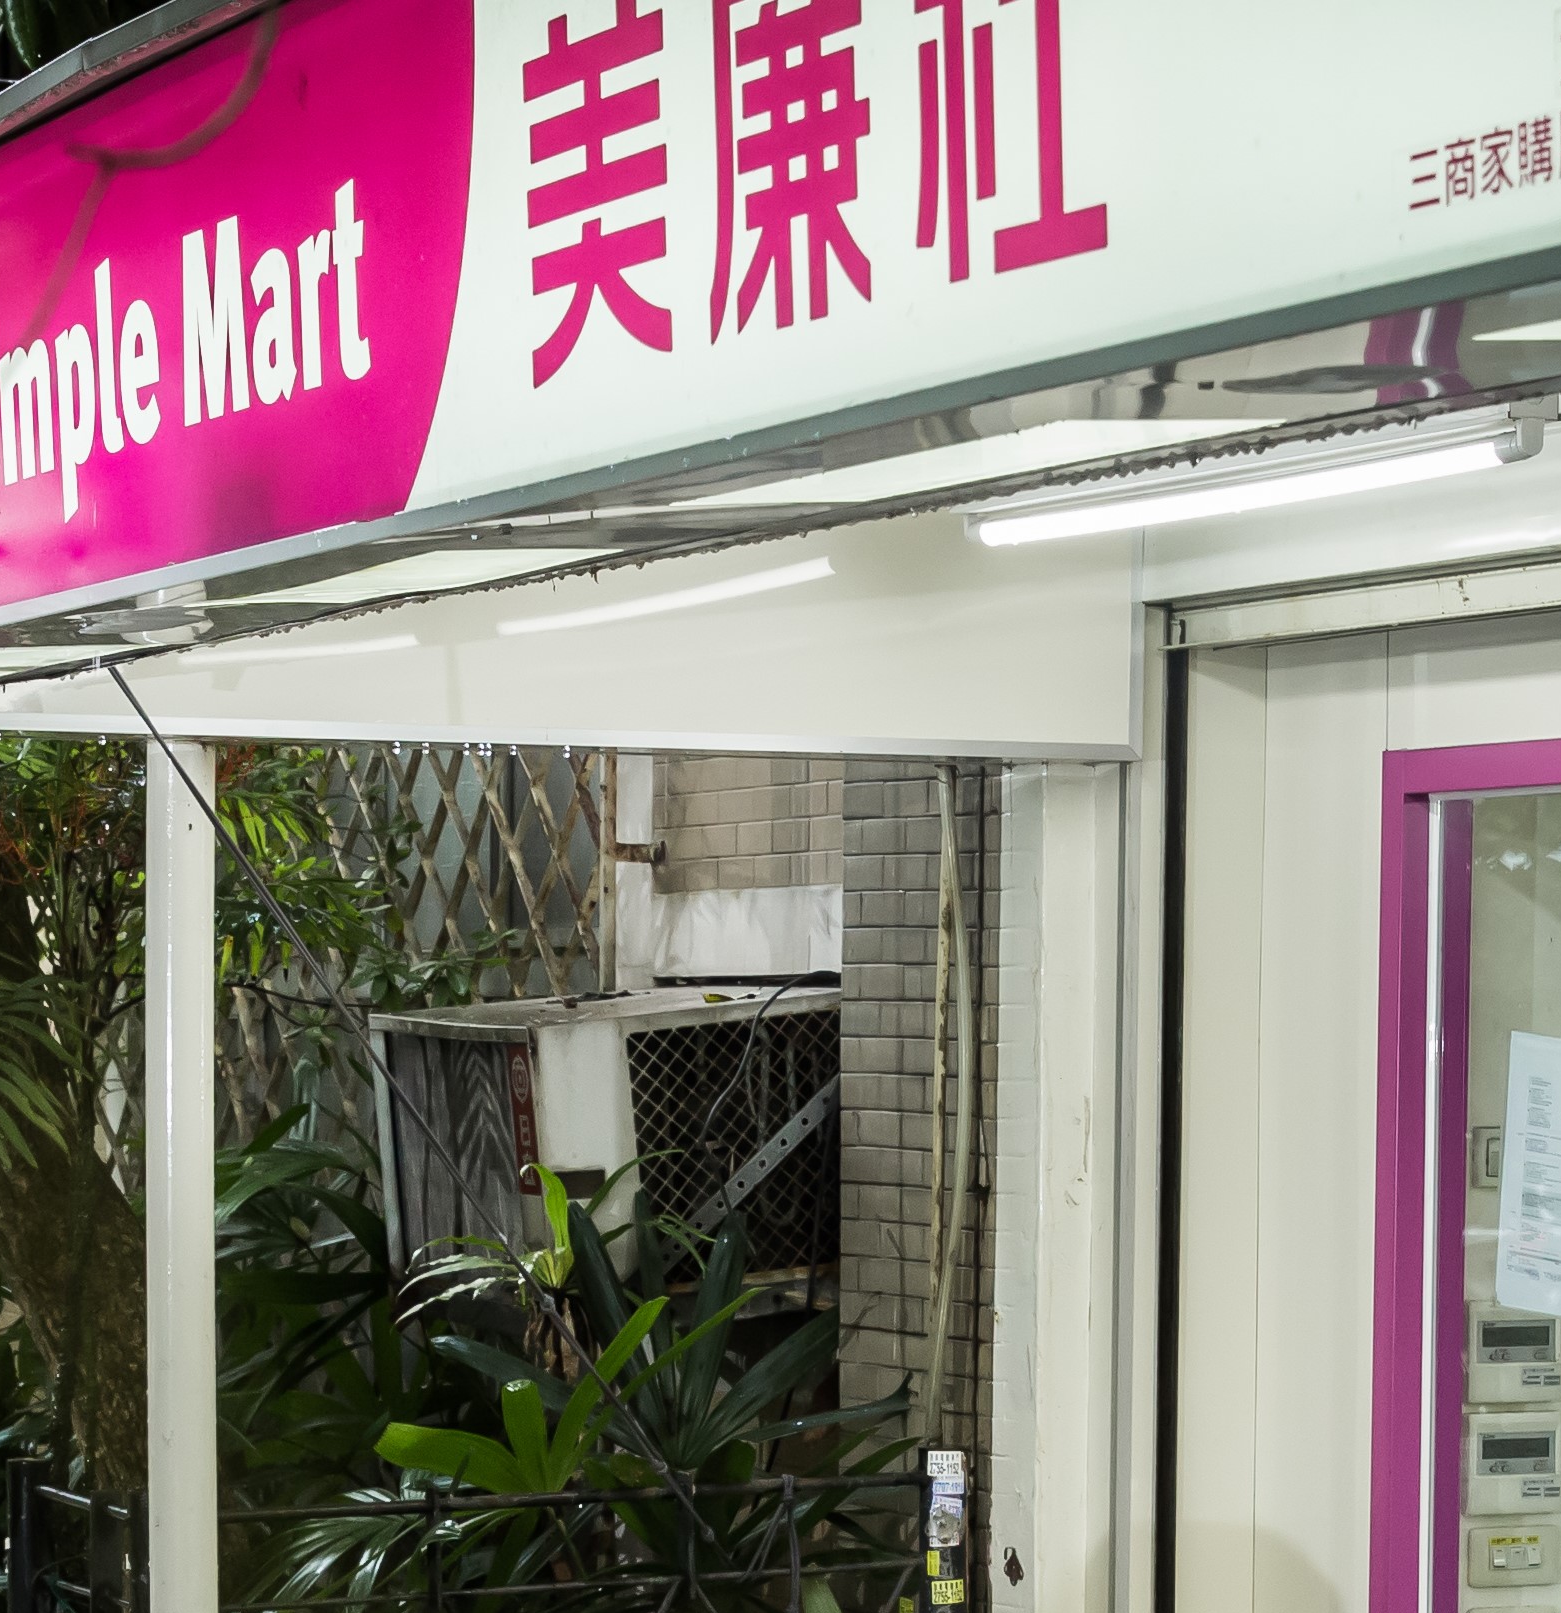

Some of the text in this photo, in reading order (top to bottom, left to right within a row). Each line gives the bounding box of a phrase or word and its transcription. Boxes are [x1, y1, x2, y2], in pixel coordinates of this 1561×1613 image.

[181, 178, 372, 428] Mart
[522, 0, 1108, 389] 美廉社
